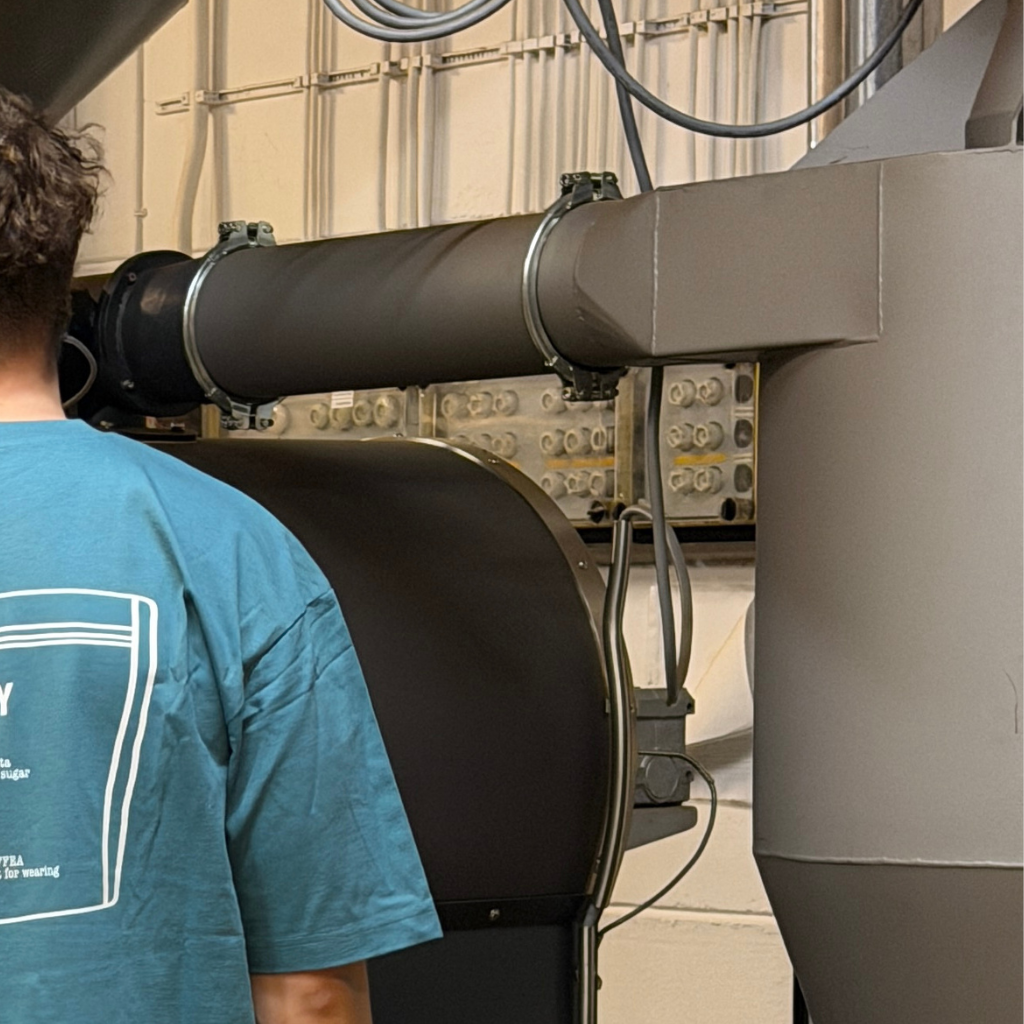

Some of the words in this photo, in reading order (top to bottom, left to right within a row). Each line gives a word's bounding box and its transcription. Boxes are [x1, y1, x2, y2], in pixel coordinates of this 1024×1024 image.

[0, 768, 31, 781] sugar
[4, 867, 20, 879] for
[21, 865, 60, 878] wearing
